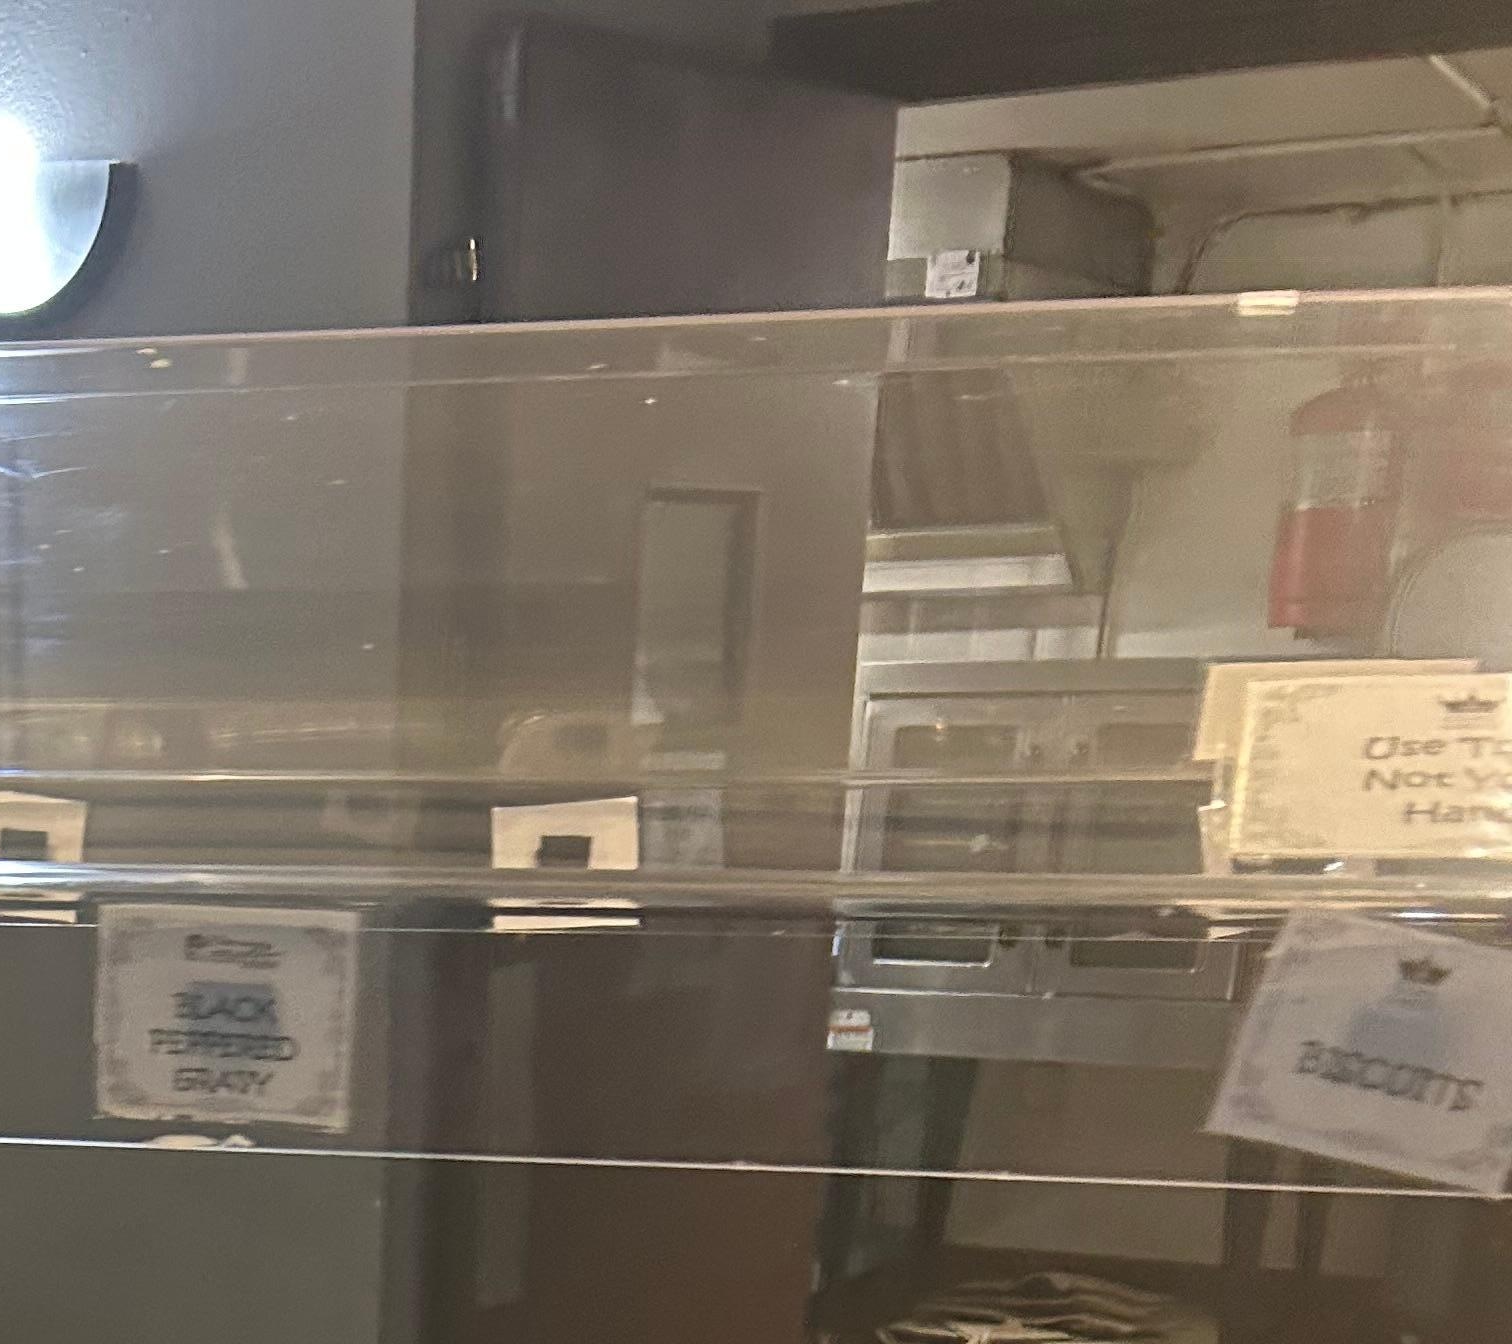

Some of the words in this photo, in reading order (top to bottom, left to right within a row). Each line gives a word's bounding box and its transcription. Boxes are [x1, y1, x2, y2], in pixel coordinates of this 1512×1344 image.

[1363, 769, 1454, 791] Not
[171, 991, 279, 1022] BLACK
[149, 1028, 299, 1061] PEPPERED
[171, 1067, 275, 1095] GRAVY
